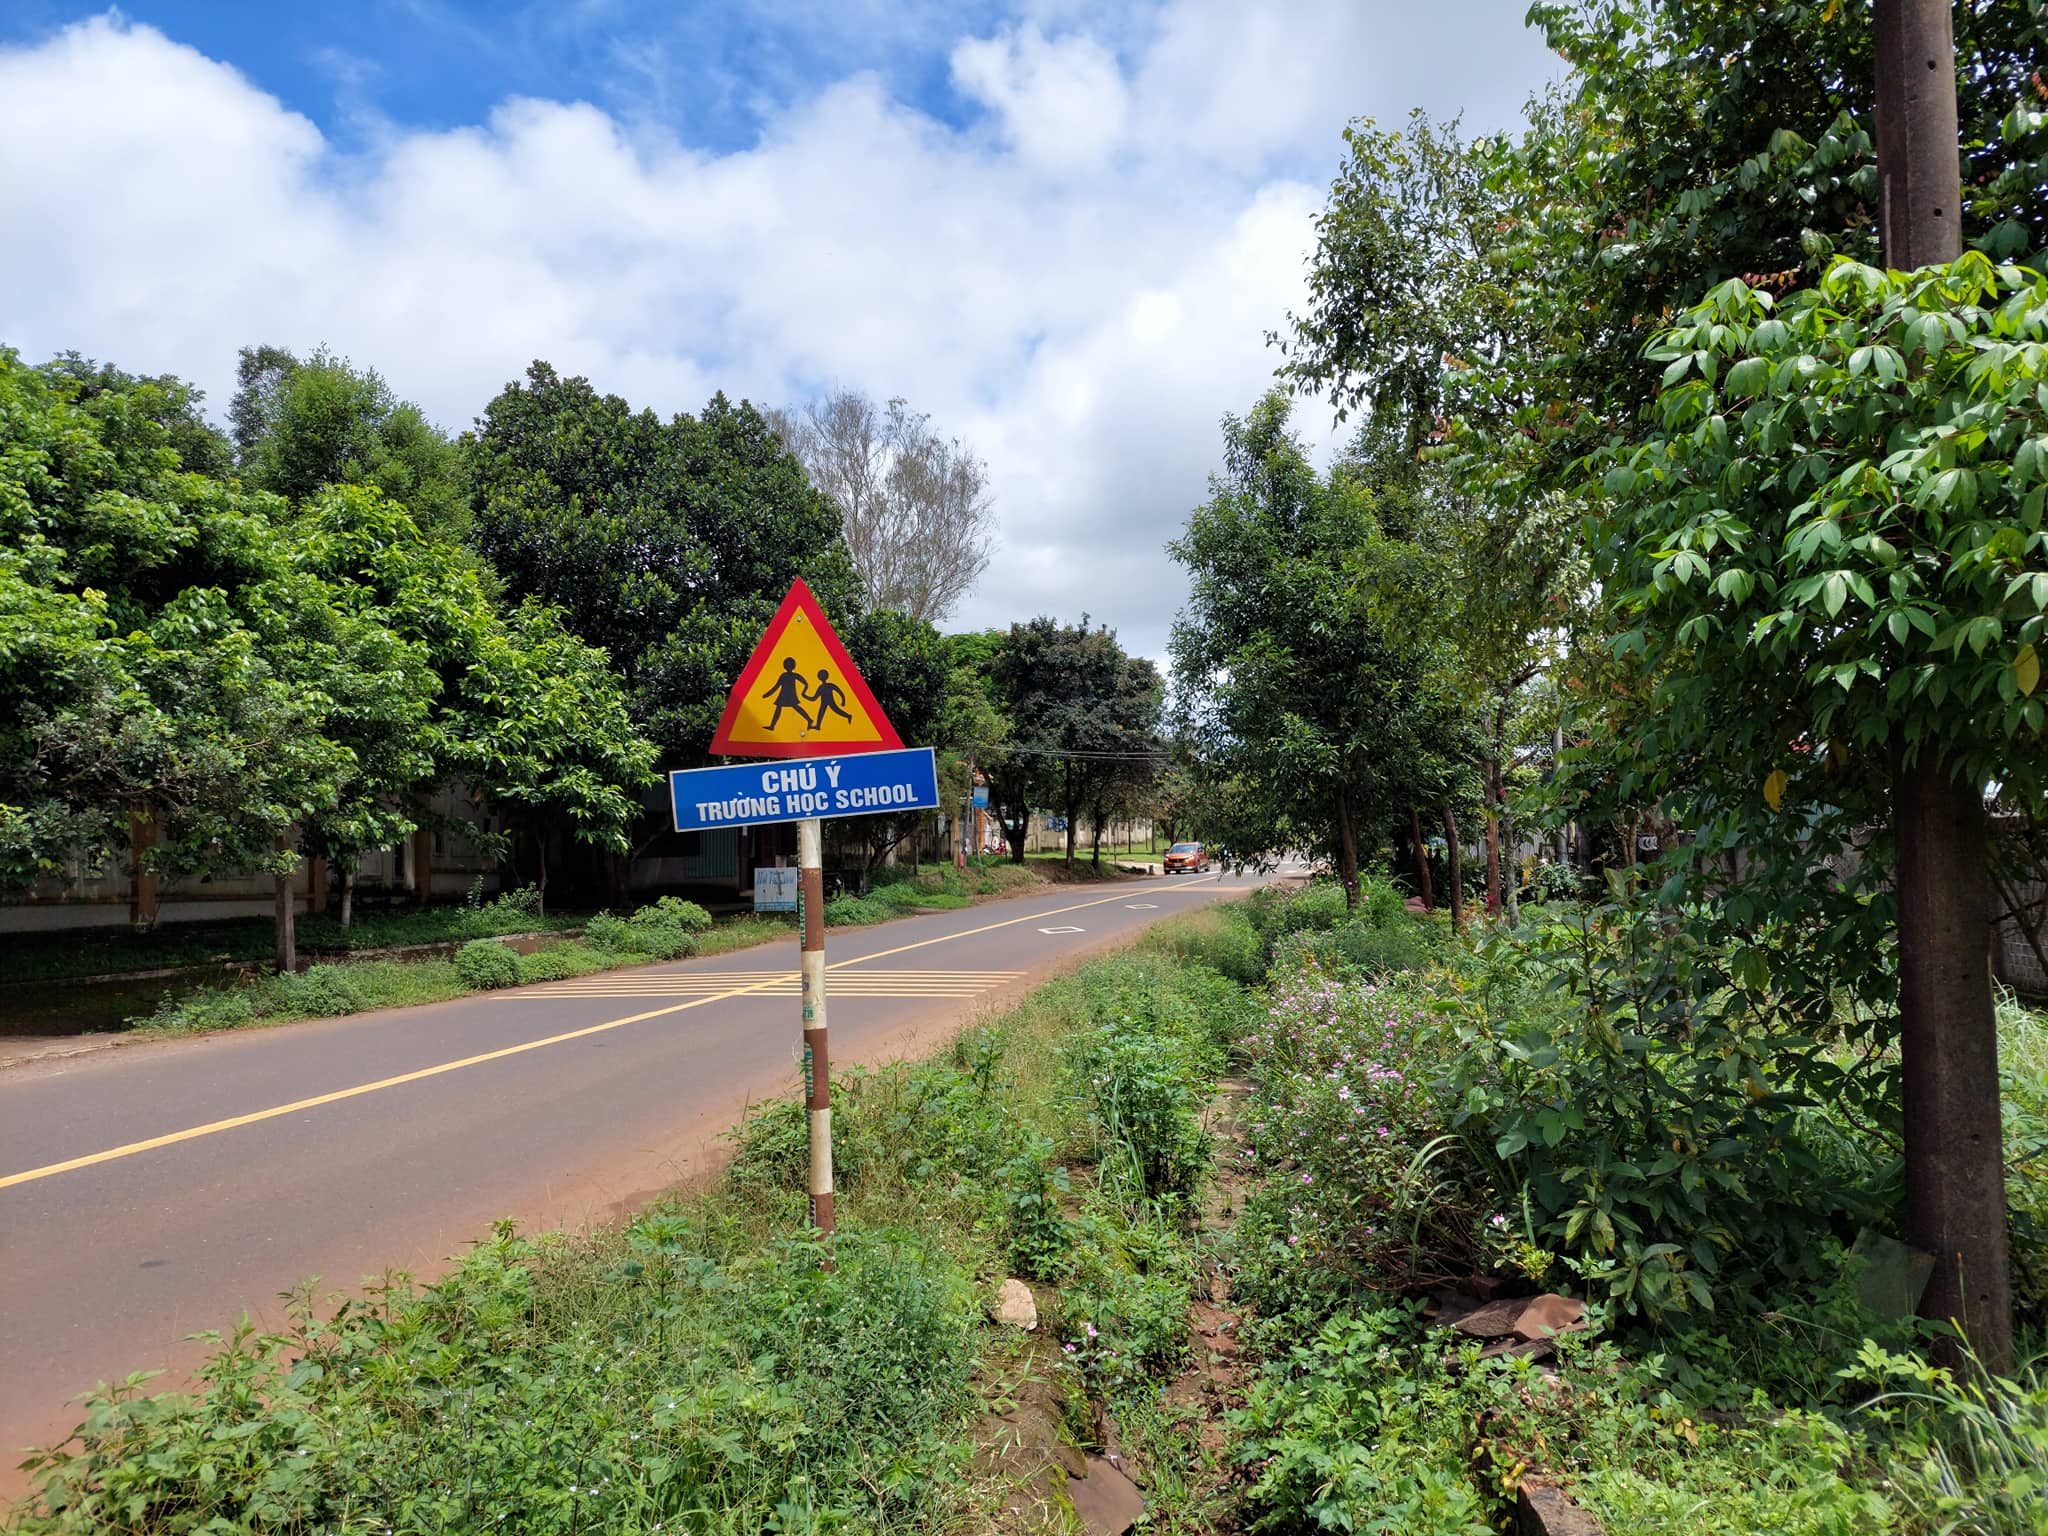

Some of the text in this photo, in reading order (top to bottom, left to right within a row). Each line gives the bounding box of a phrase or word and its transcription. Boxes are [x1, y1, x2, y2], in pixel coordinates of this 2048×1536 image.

[762, 760, 841, 794] CHÚ Ý
[696, 784, 918, 822] TRƯỜNG HỌC SCHOOL
